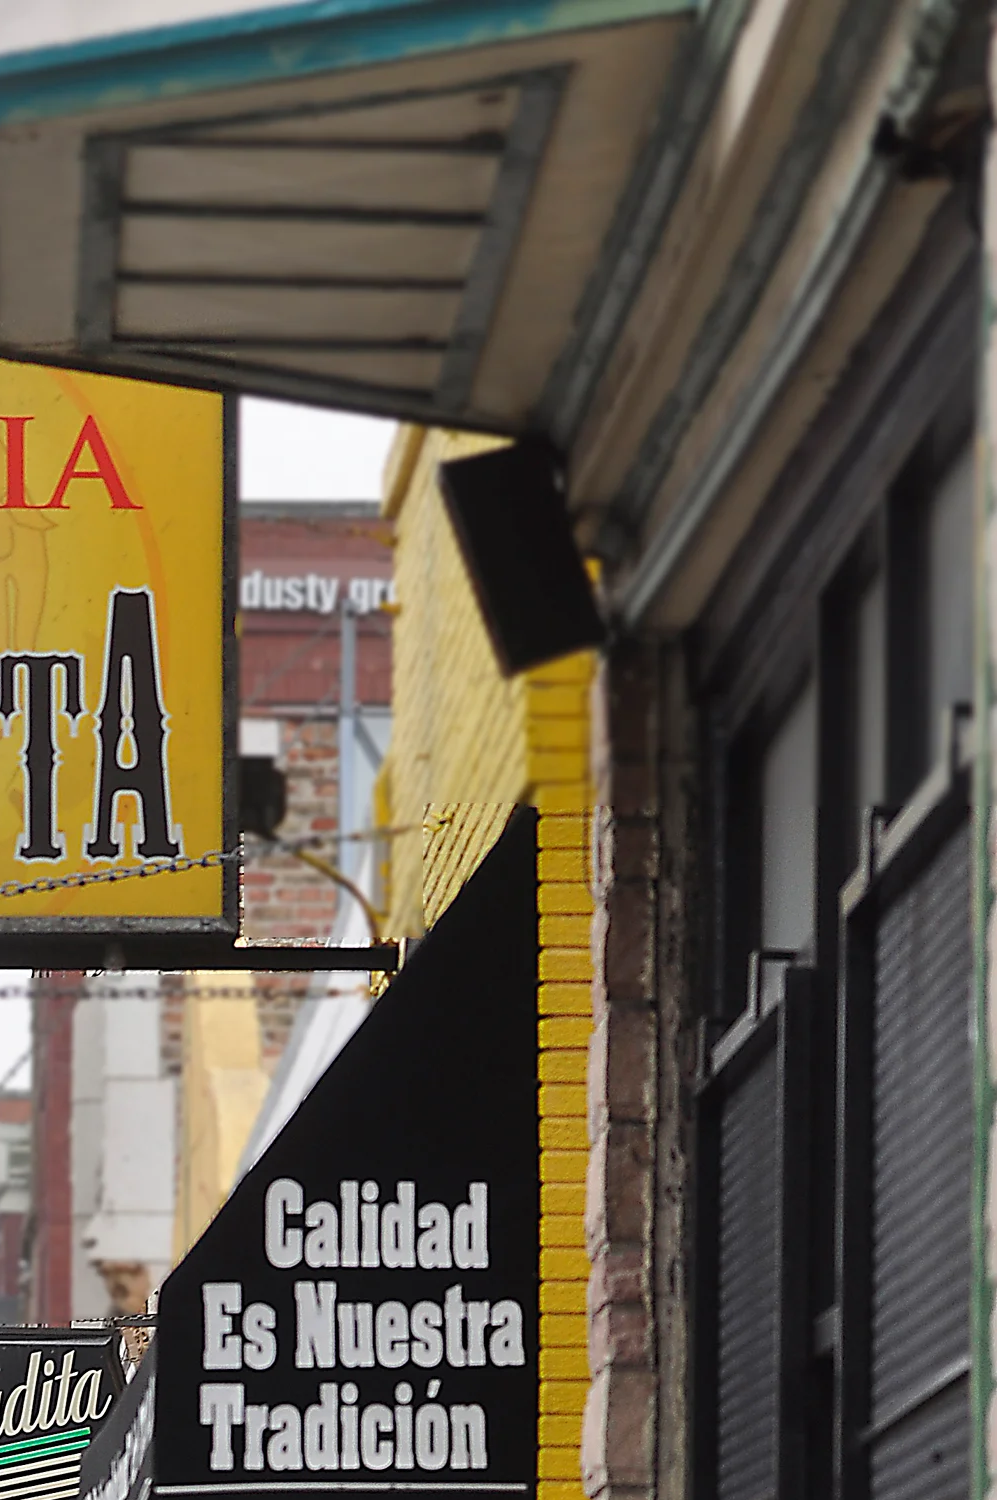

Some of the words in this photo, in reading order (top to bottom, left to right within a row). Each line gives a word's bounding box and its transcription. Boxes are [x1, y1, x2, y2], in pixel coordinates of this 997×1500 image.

[240, 569, 339, 613] dusty
[265, 1178, 489, 1270] Calidad
[202, 1282, 277, 1370] Es
[294, 1280, 526, 1369] Nuestra
[199, 1379, 489, 1472] Tradición
